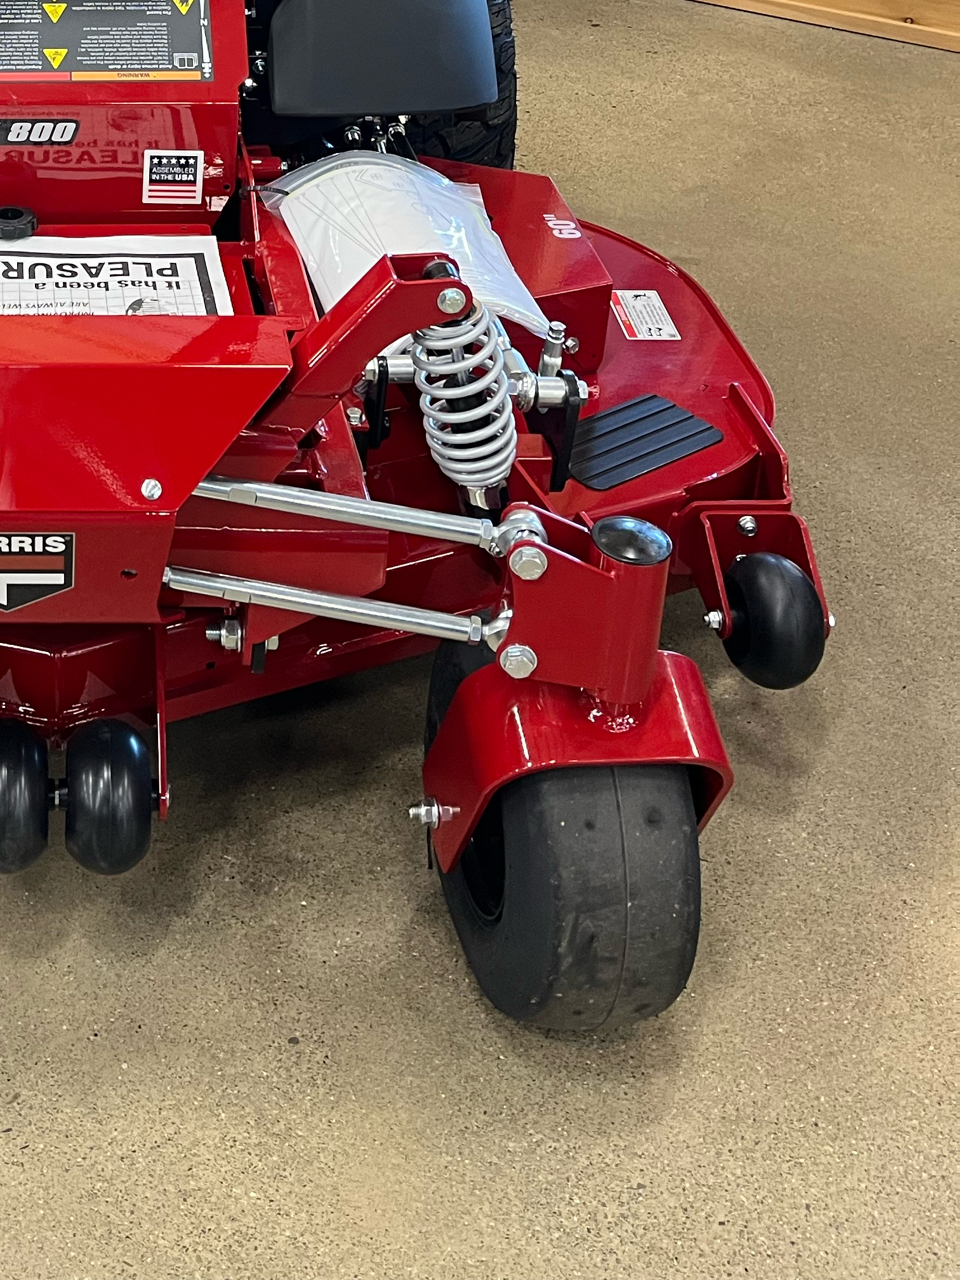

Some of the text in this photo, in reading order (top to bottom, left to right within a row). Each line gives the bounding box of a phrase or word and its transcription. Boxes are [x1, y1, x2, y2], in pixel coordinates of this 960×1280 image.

[7, 122, 79, 142] 800
[152, 166, 195, 174] ASSEMBLED
[175, 173, 195, 181] USA
[33, 280, 180, 292] It has been a
[25, 302, 67, 310] ALWAYS
[70, 302, 89, 310] ARE
